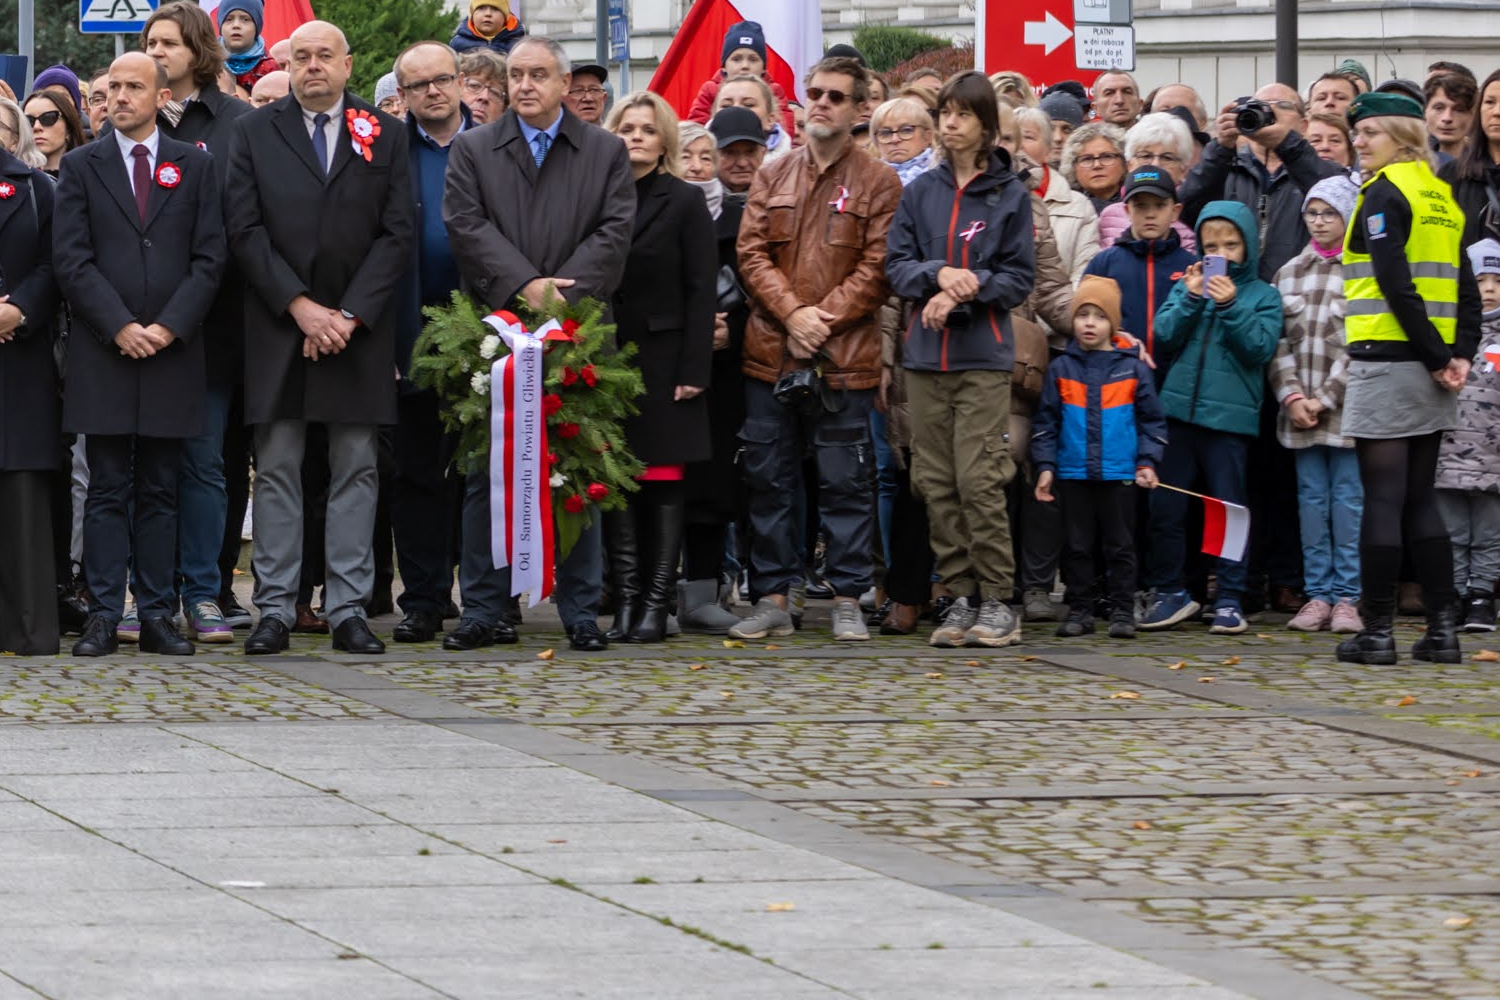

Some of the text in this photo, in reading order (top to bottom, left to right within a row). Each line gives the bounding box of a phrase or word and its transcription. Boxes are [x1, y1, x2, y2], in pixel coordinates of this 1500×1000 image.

[1093, 28, 1114, 36] PŁATNY
[522, 411, 534, 461] Powiatu
[521, 469, 535, 541] Samorządu
[520, 553, 530, 571] Od
